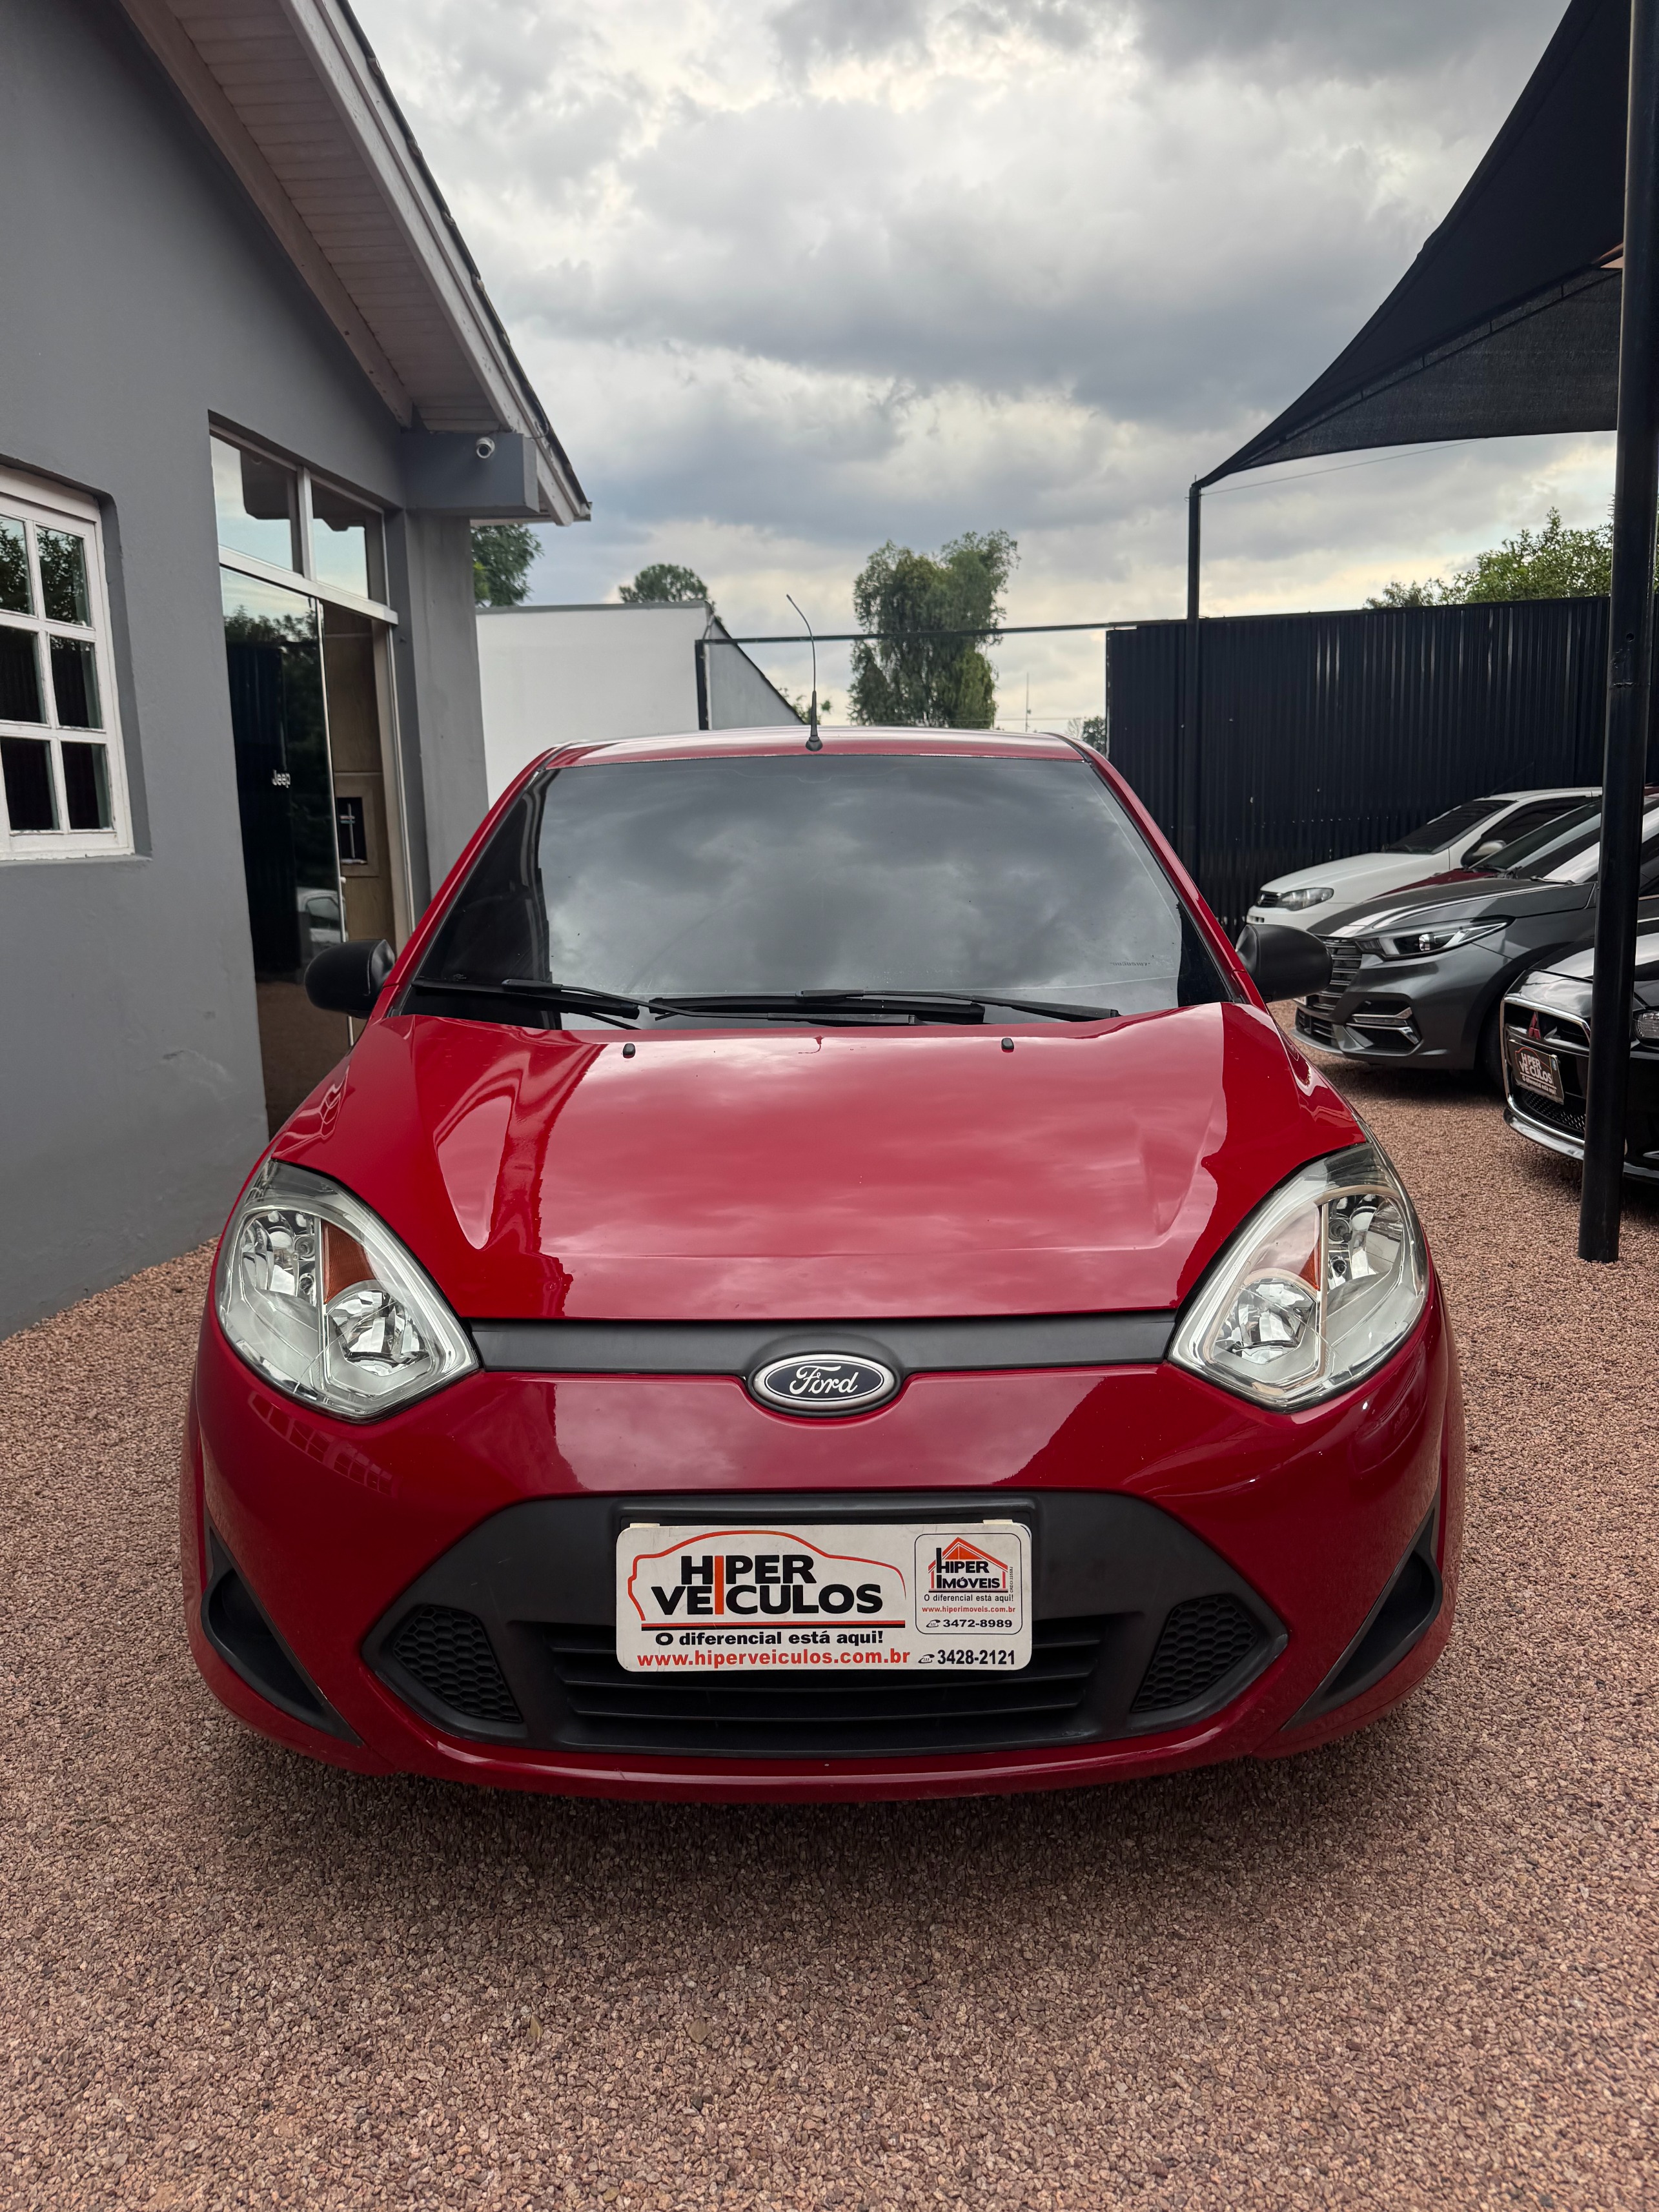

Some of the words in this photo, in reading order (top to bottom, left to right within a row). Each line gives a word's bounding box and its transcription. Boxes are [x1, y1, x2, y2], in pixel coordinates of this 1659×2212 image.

[272, 769, 290, 788] Jeep
[789, 1365, 859, 1395] Ford
[936, 1547, 990, 1574] HIPER
[681, 1554, 817, 1586] HIPER
[936, 1574, 1001, 1589] IMÓVEIS
[995, 1594, 1014, 1603] aqui!
[942, 1619, 1012, 1628] 3472-8989
[655, 1632, 674, 1646] O
[679, 1631, 782, 1646] diferencial
[788, 1630, 830, 1645] está
[836, 1630, 883, 1647] aqui!
[637, 1649, 911, 1669] www.hiperveiculos.com.br
[937, 1649, 1015, 1665] 3428-2121
